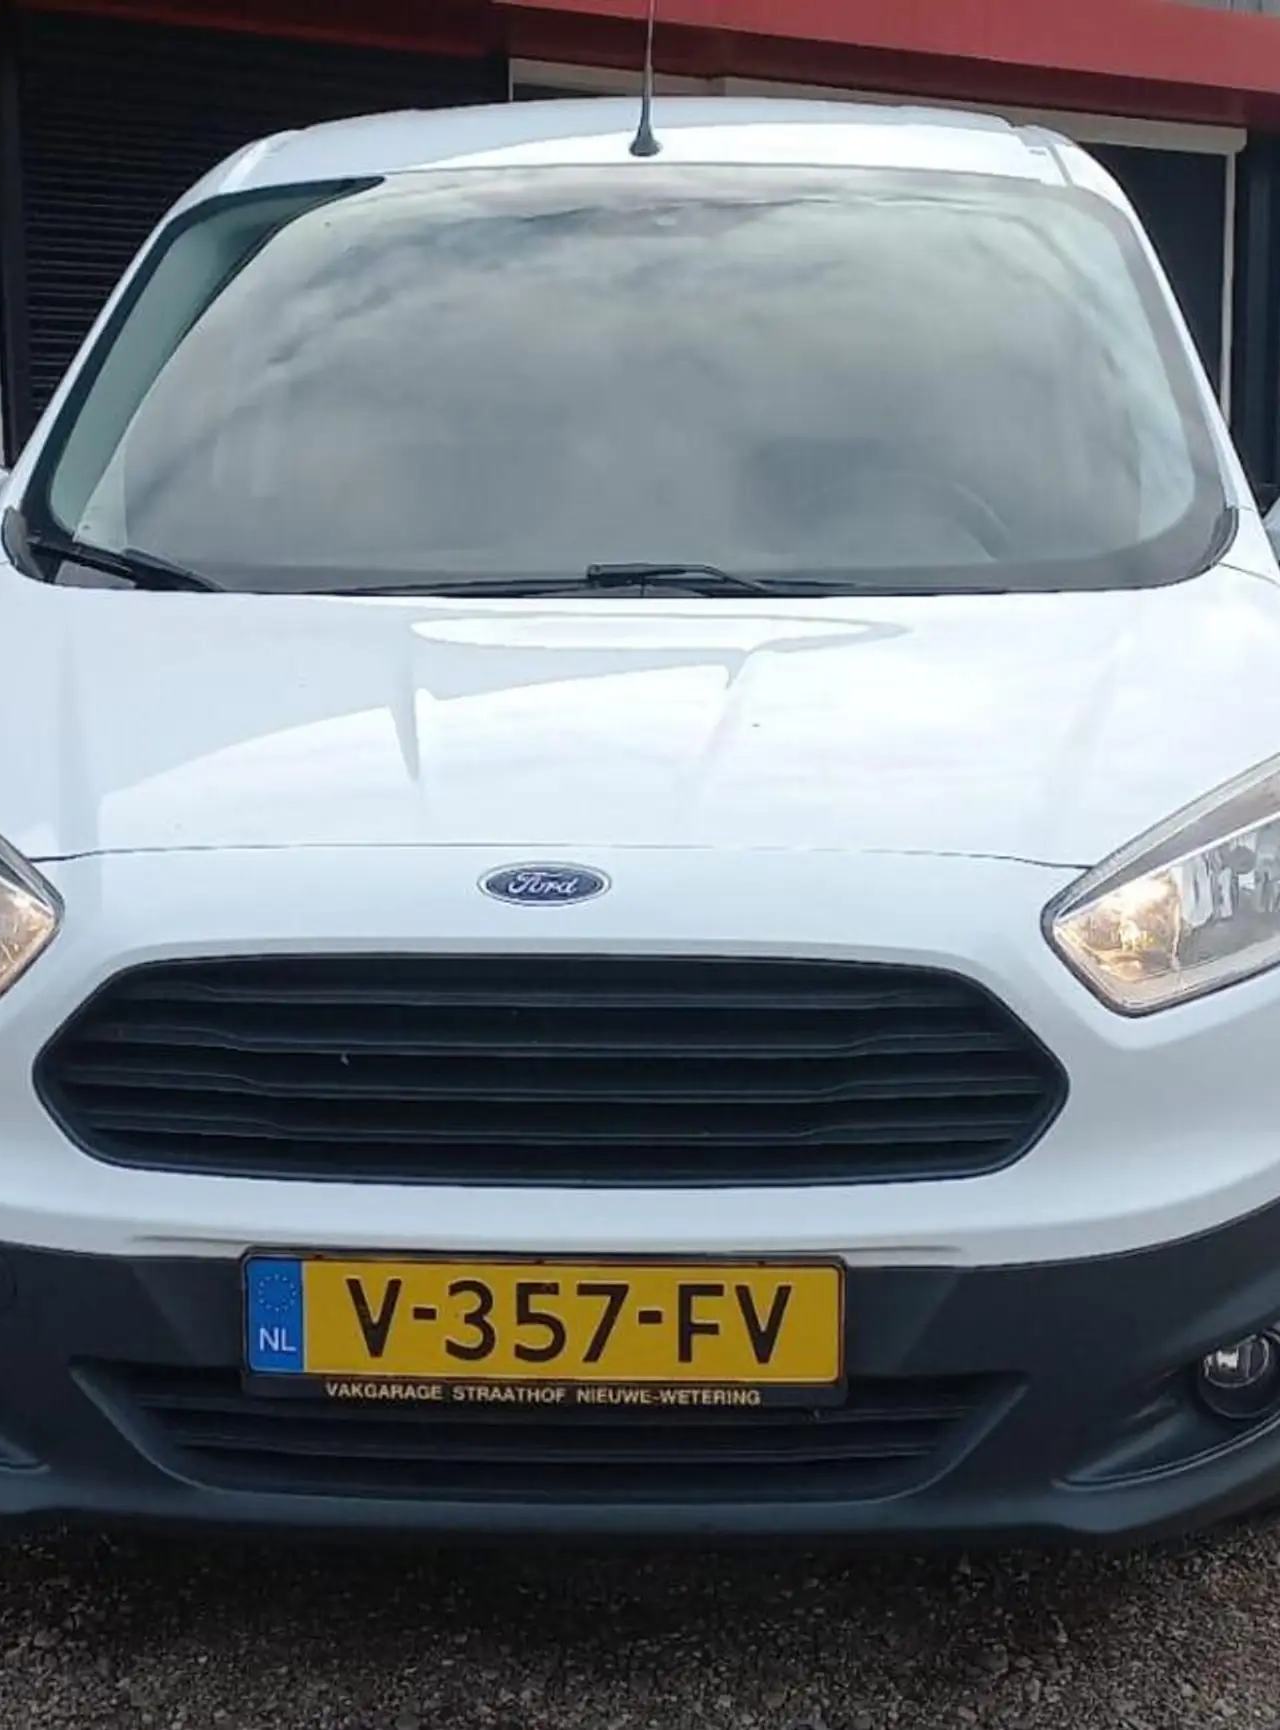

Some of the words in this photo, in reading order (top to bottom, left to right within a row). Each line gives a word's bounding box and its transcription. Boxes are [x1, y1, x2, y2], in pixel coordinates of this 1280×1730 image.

[507, 872, 579, 894] Ford
[259, 1327, 297, 1352] NL
[345, 1277, 793, 1364] V-357-FV
[325, 1382, 443, 1400] VAKGARAGE
[452, 1385, 566, 1403] STRAATHOF
[576, 1387, 762, 1406] NIEUWE-WETERING
